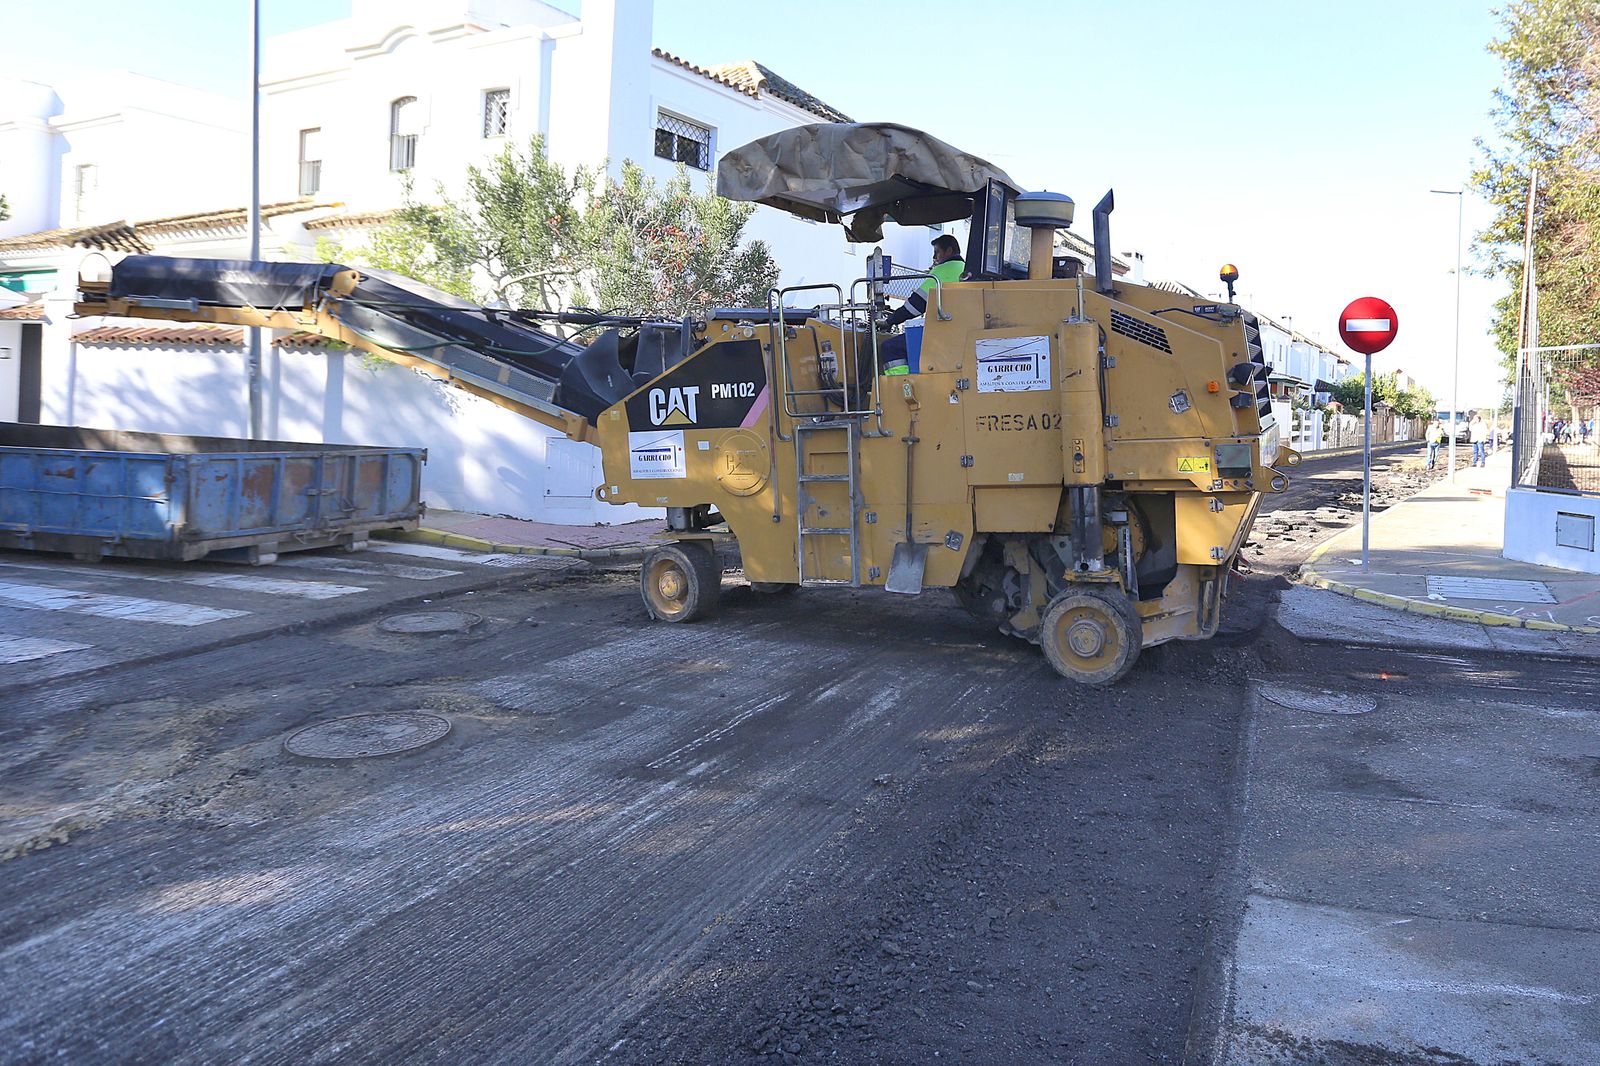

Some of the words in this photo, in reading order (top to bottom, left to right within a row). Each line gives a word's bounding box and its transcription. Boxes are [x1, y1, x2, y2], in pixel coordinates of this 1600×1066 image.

[987, 363, 1032, 373] GARRUCHO
[711, 381, 756, 399] PM102
[648, 385, 700, 426] CAT
[976, 413, 1038, 432] FRESA
[1041, 412, 1062, 430] 02
[638, 454, 671, 462] GARRUCHO
